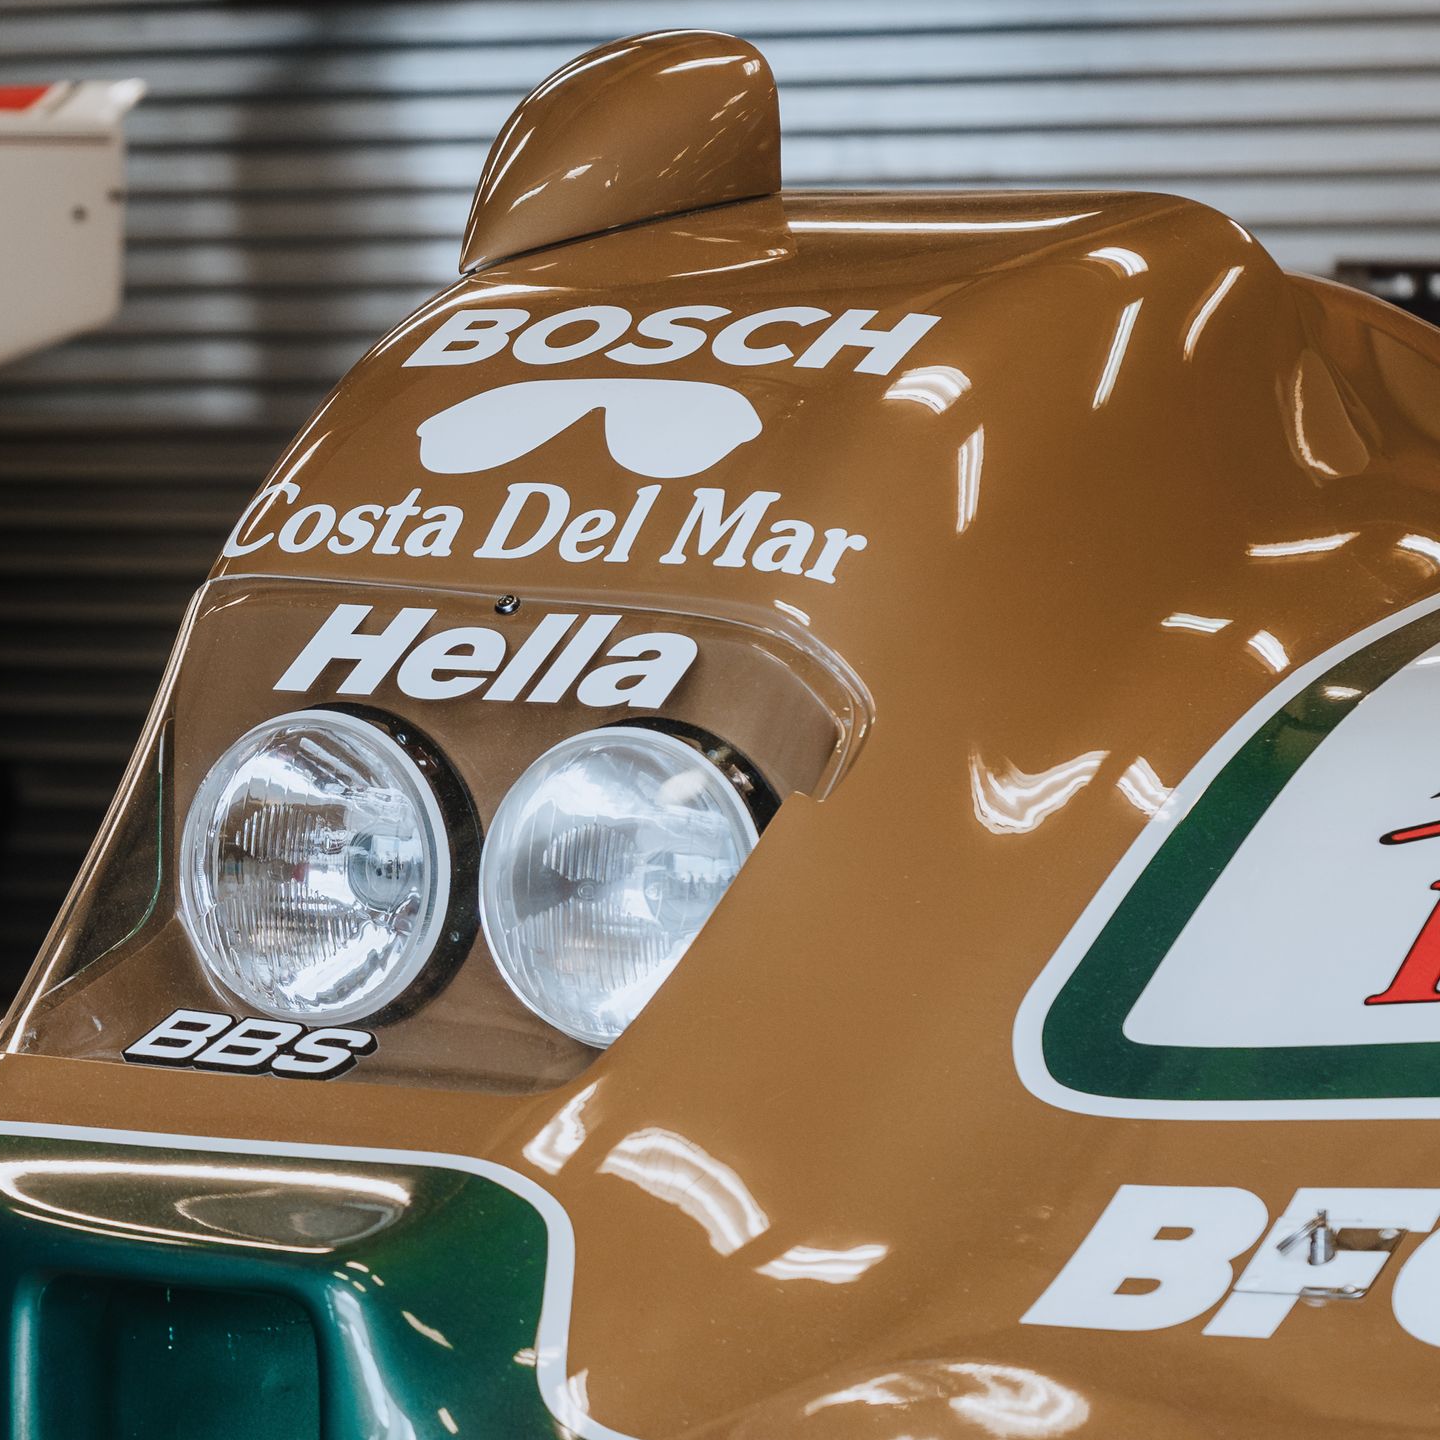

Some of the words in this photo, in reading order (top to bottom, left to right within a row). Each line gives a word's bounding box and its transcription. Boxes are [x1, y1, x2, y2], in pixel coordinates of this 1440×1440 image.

[401, 304, 943, 377] BOSCH
[224, 481, 463, 559] Costa
[473, 481, 662, 563] Del
[663, 486, 868, 585] Mar
[273, 603, 699, 709] Hella
[121, 1008, 380, 1080] BBS
